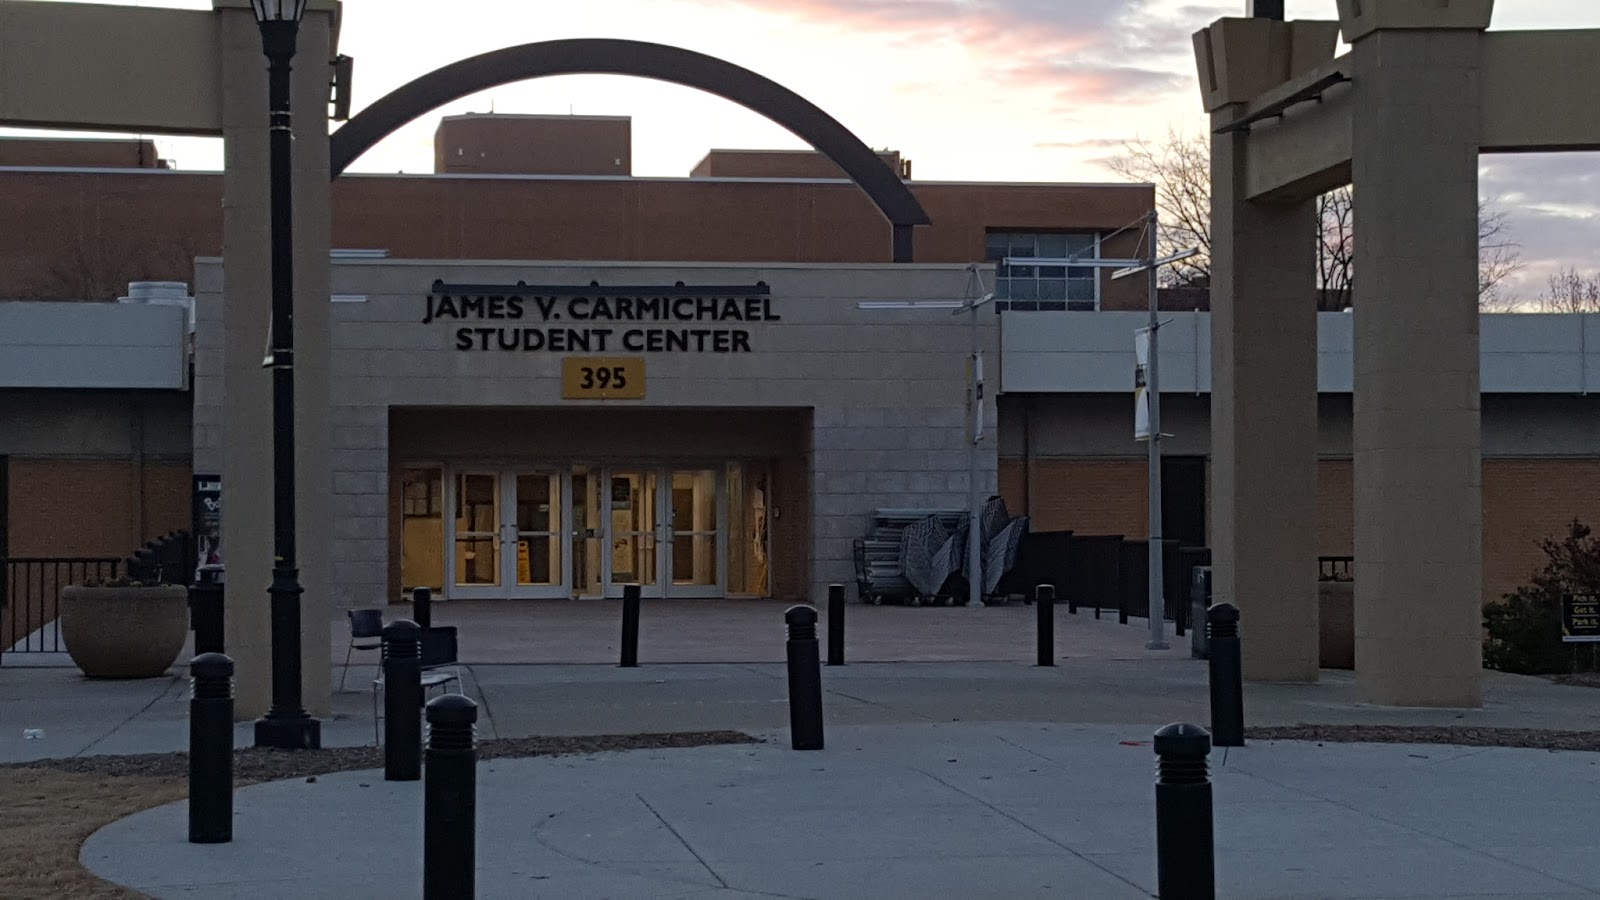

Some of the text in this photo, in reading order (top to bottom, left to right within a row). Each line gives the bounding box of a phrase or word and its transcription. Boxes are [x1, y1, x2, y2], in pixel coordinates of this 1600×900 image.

[422, 295, 781, 324] JAMES V. CARMICHAEL
[456, 328, 751, 352] STUDENT CENTER
[580, 367, 626, 390] 395
[1572, 617, 1590, 626] Park
[1574, 606, 1588, 614] Get
